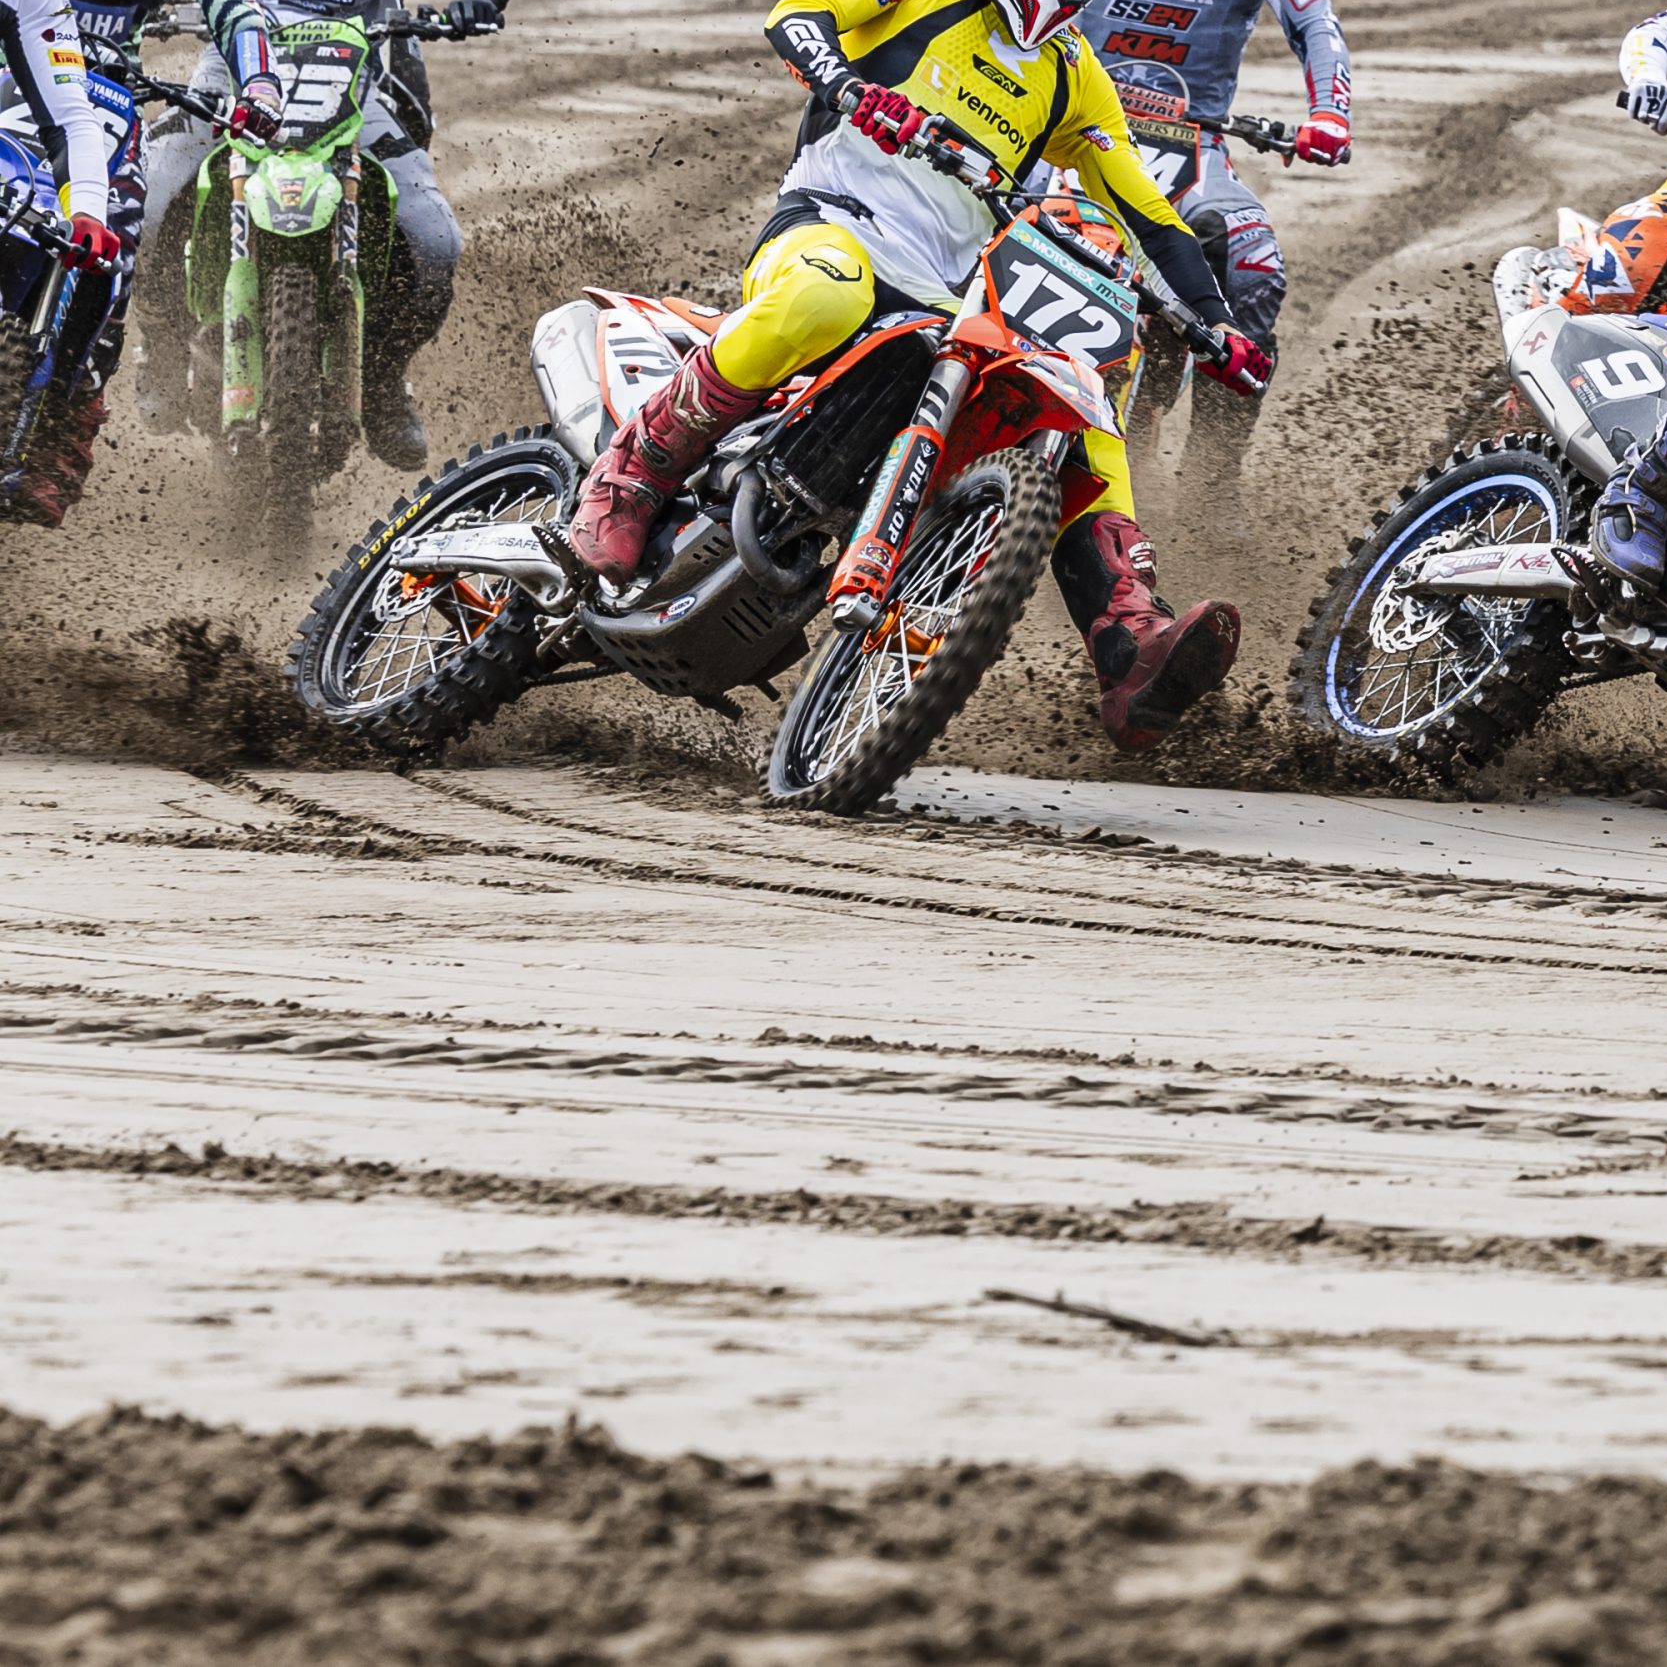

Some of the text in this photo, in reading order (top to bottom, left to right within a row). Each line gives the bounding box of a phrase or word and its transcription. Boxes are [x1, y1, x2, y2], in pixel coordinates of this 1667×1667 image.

[1103, 29, 1191, 66] KTM
[956, 85, 1028, 155] venrooy
[1172, 127, 1196, 142] LTD
[1029, 237, 1095, 288] MOTOREX
[999, 259, 1122, 369] 172
[1580, 349, 1667, 401] 9
[357, 492, 433, 571] DUNLOP
